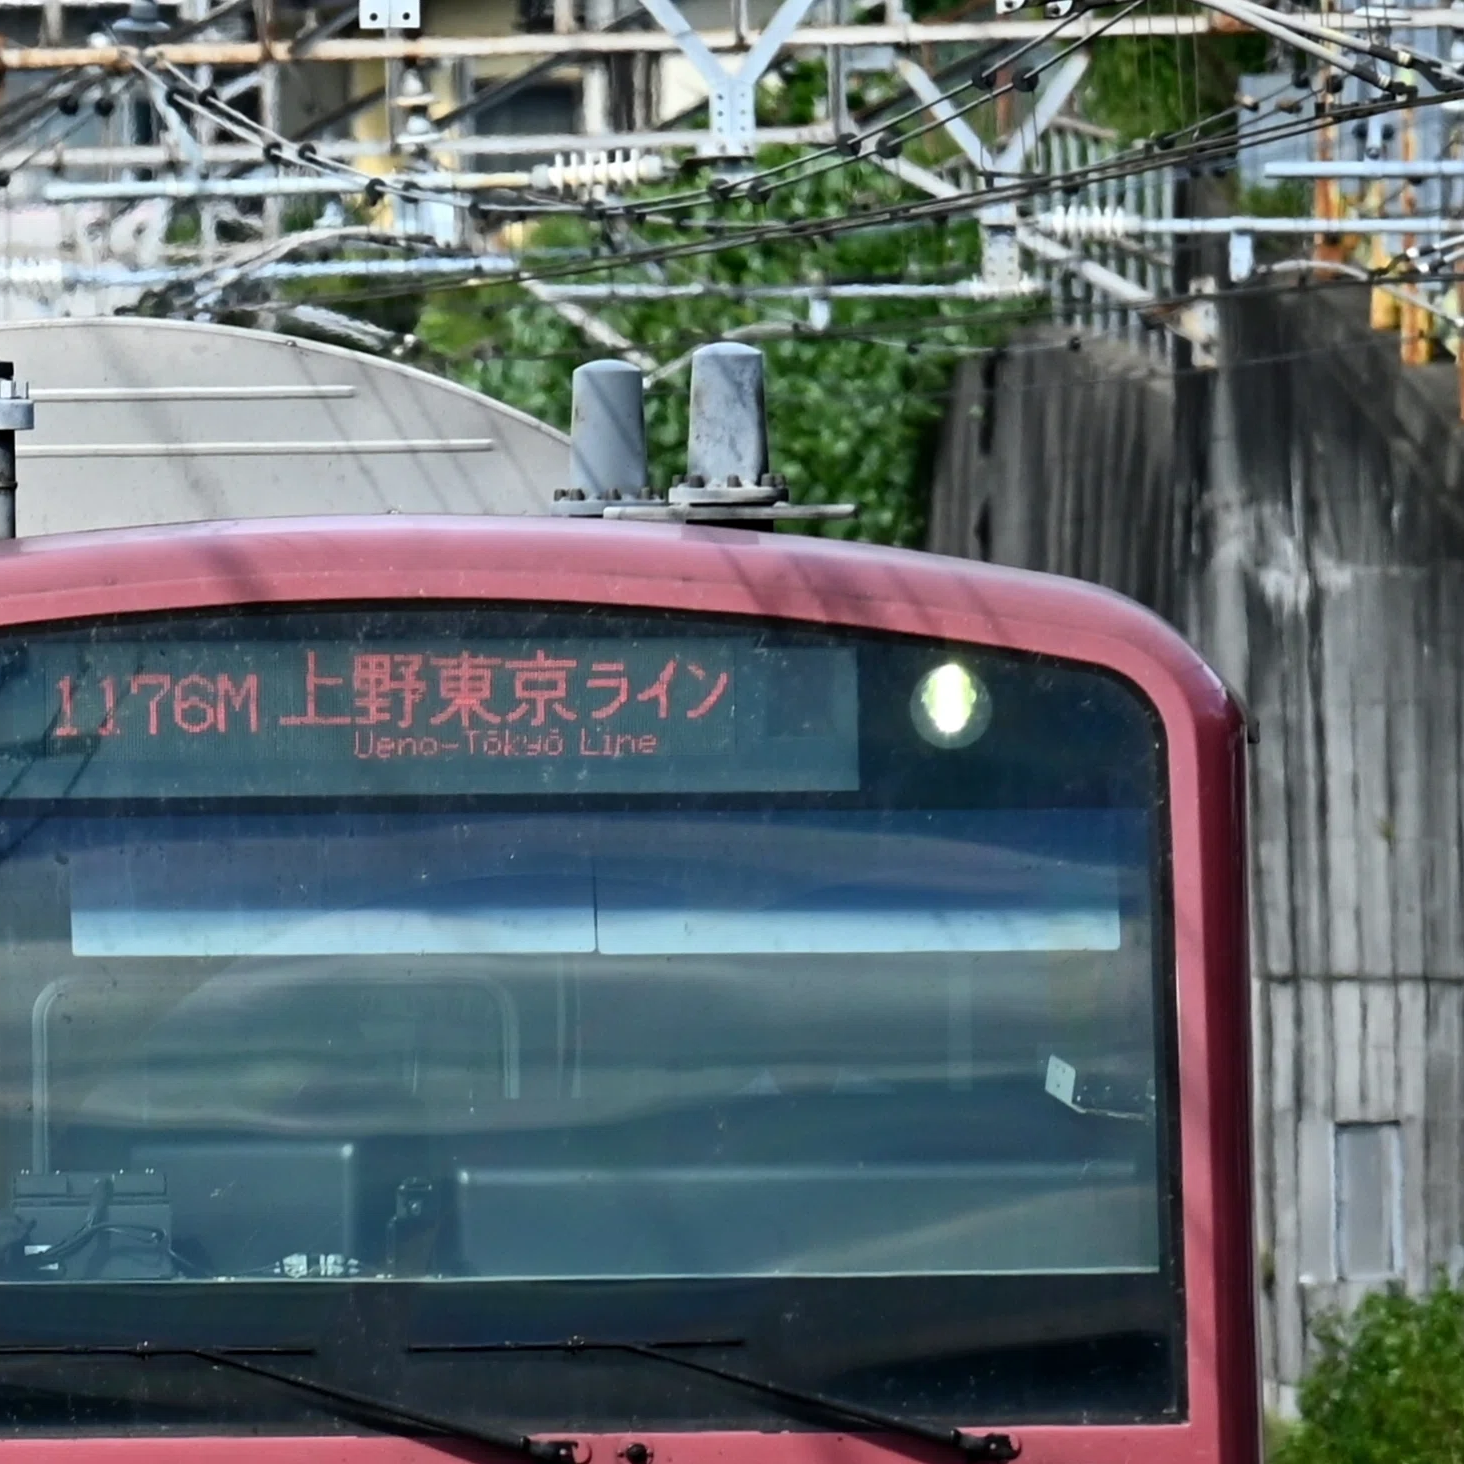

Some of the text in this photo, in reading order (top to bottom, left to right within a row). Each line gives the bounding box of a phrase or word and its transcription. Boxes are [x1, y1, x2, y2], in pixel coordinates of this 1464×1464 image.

[54, 649, 728, 737] 1176M 上野東京ライン
[579, 727, 658, 757] Line
